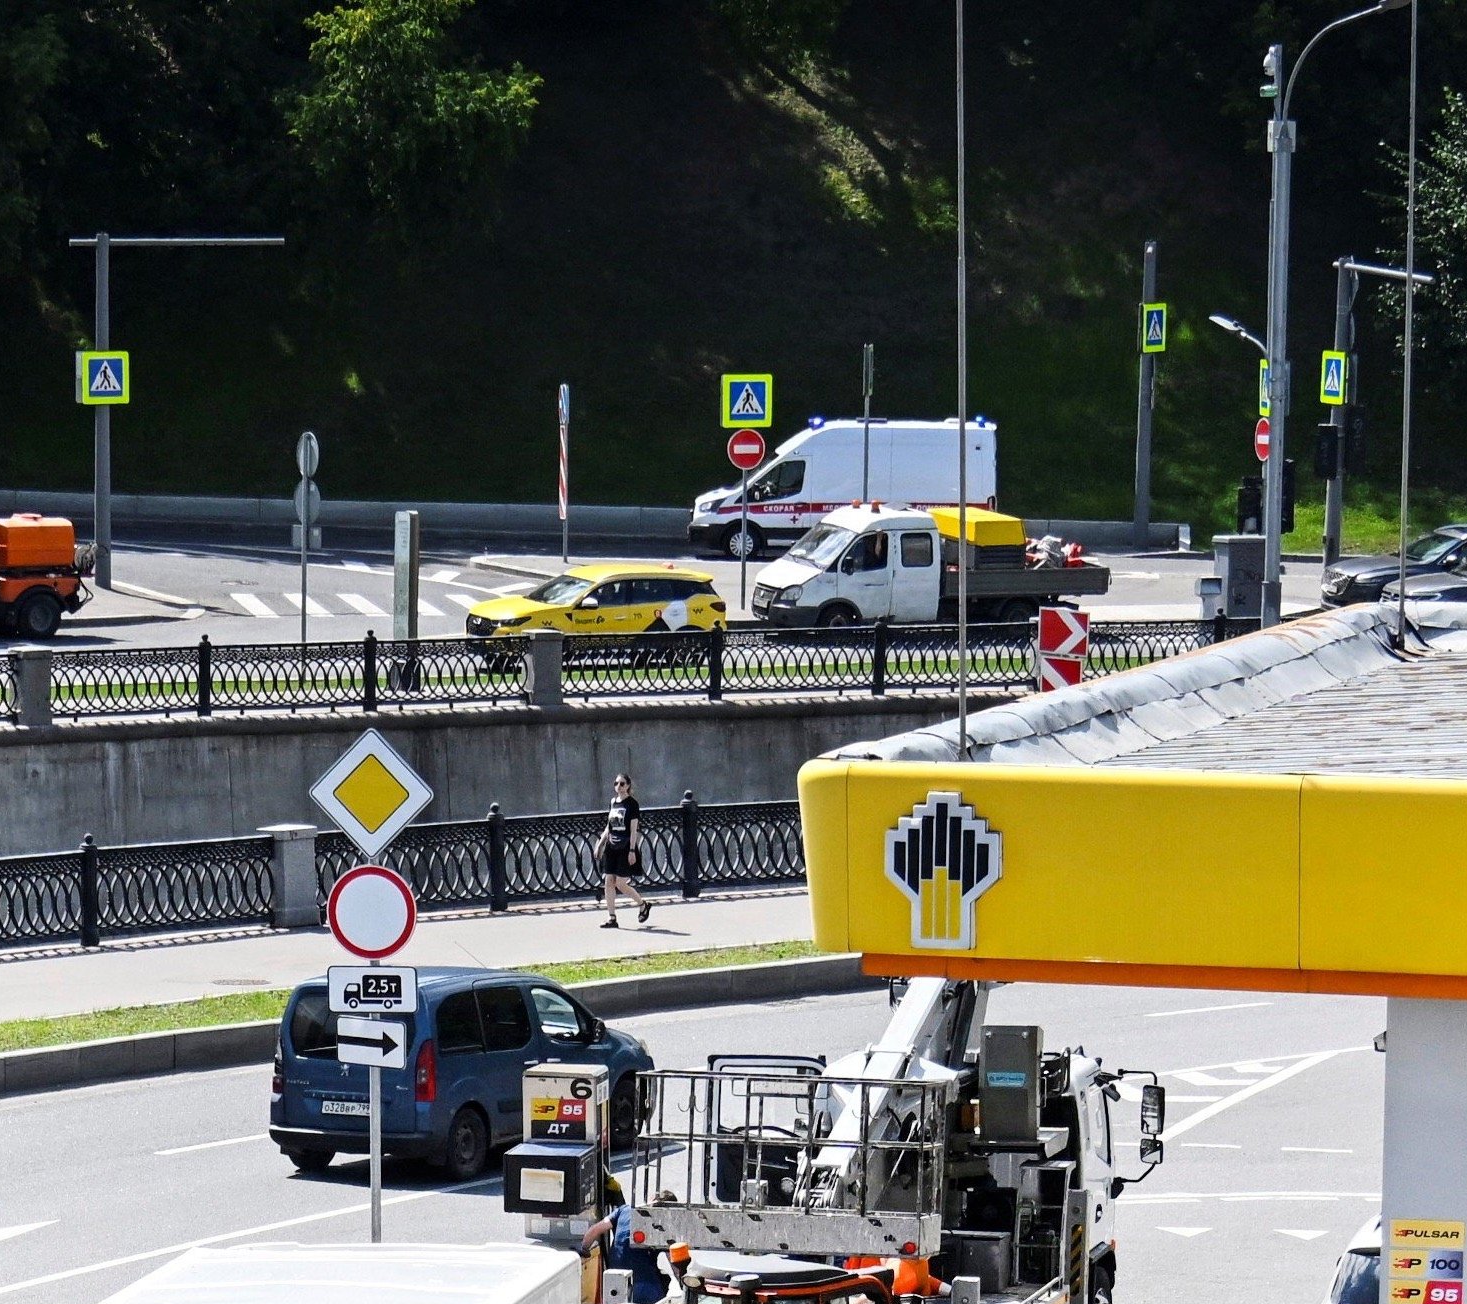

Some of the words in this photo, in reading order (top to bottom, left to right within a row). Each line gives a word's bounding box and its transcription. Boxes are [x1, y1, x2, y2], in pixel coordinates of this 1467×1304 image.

[763, 504, 795, 513] СКОРАЯ
[570, 1078, 592, 1099] 6
[562, 1104, 583, 1115] 95
[547, 1124, 570, 1134] ДТ
[1404, 1229, 1460, 1239] PULSAR
[1430, 1259, 1460, 1271] 100
[1430, 1288, 1458, 1303] 95
